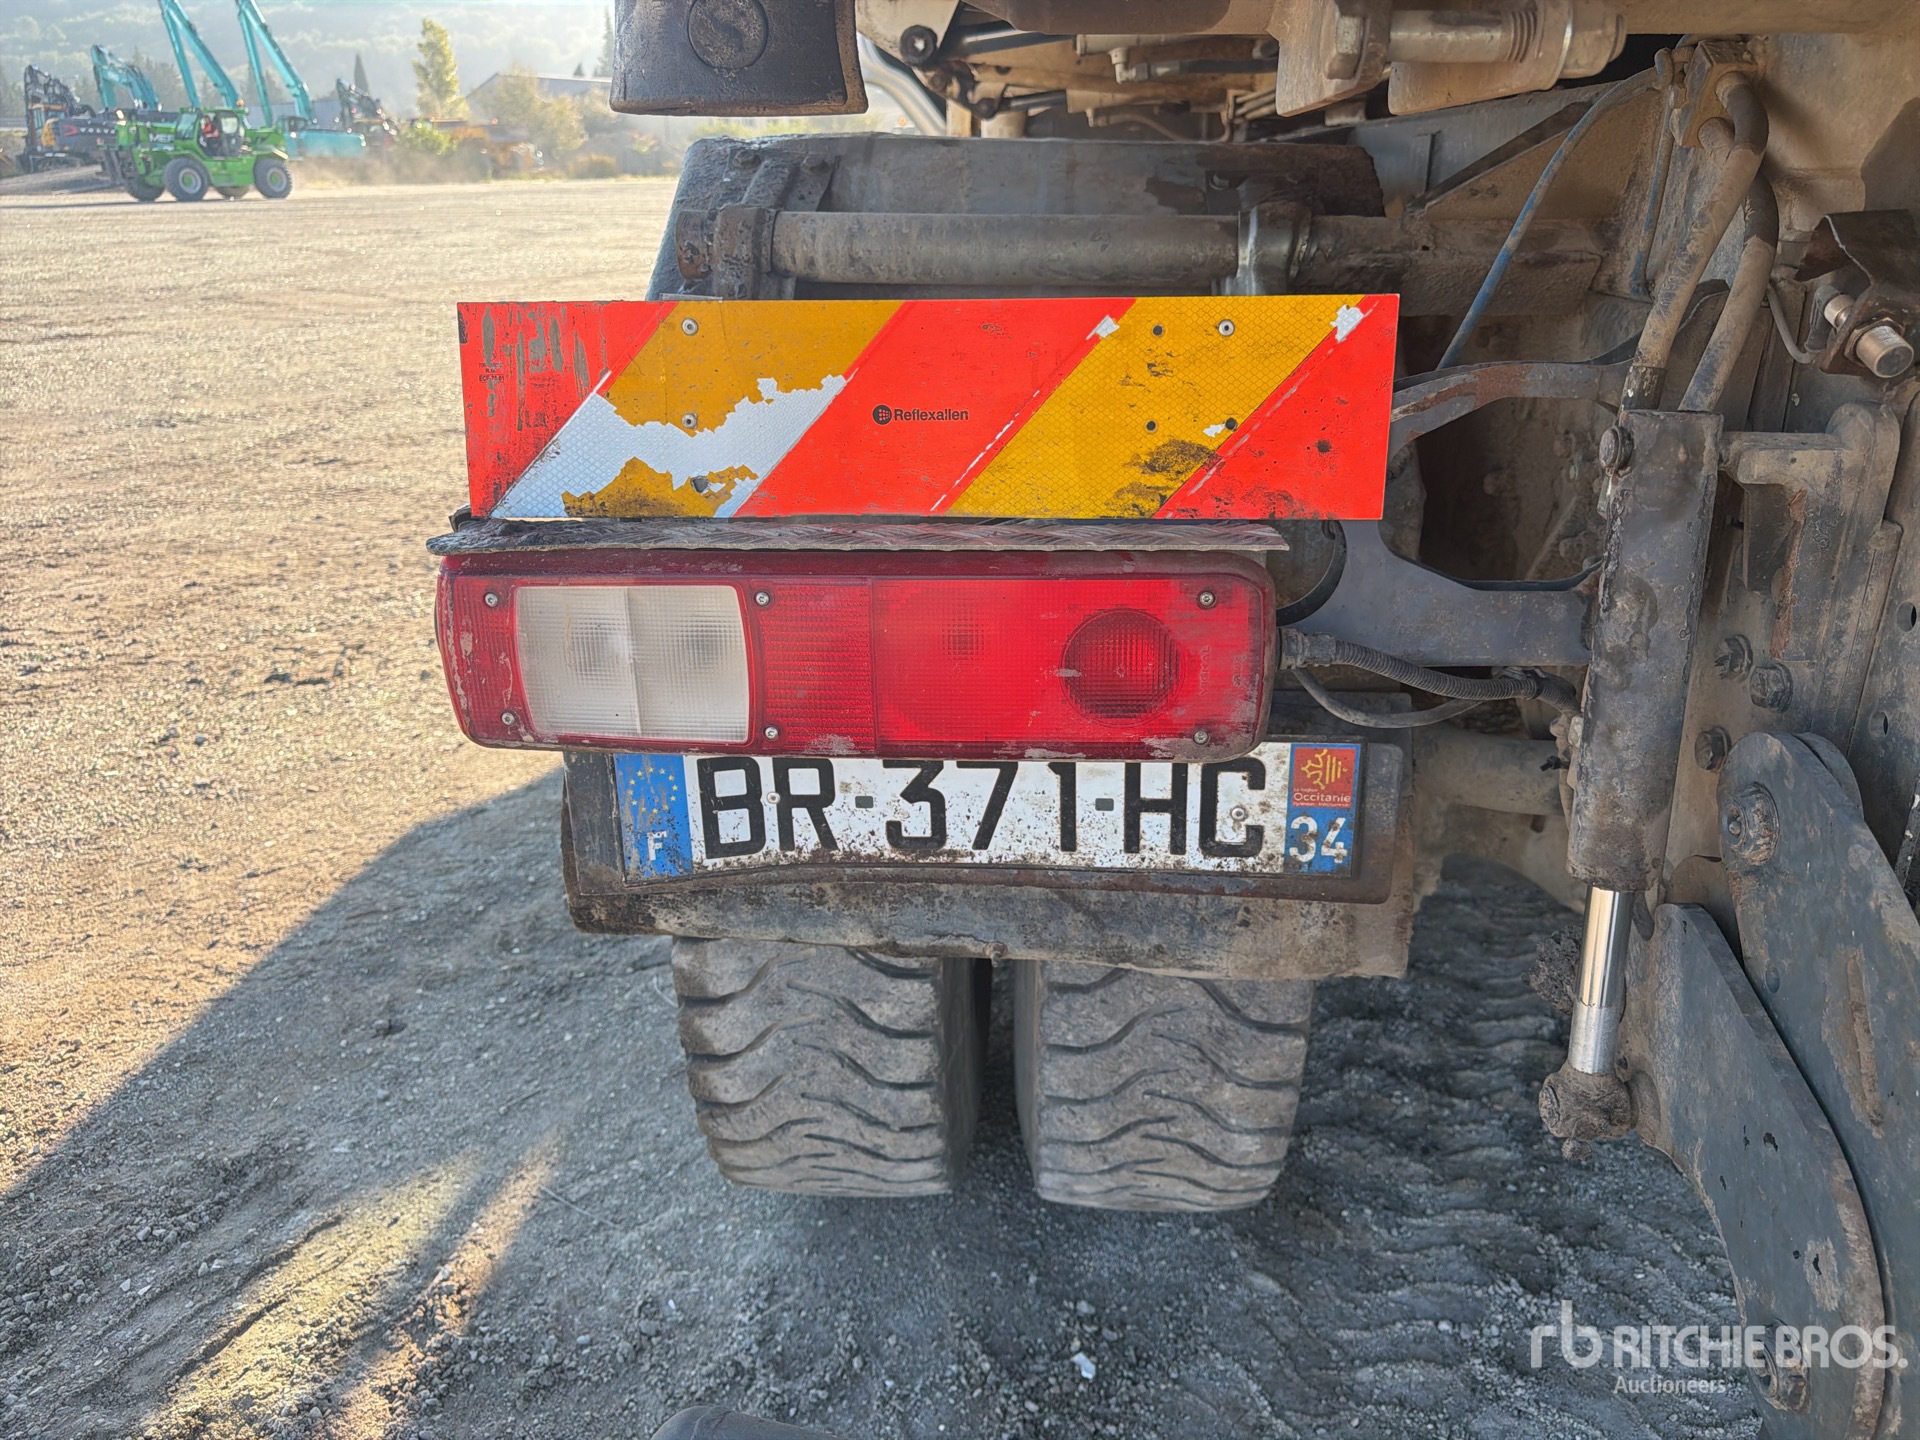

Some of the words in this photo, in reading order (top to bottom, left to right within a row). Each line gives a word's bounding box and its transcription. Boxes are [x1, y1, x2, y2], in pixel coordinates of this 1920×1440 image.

[894, 408, 968, 421] Reflexallen
[1293, 791, 1352, 803] Occitanie
[647, 830, 667, 861] F
[1289, 816, 1348, 864] 34
